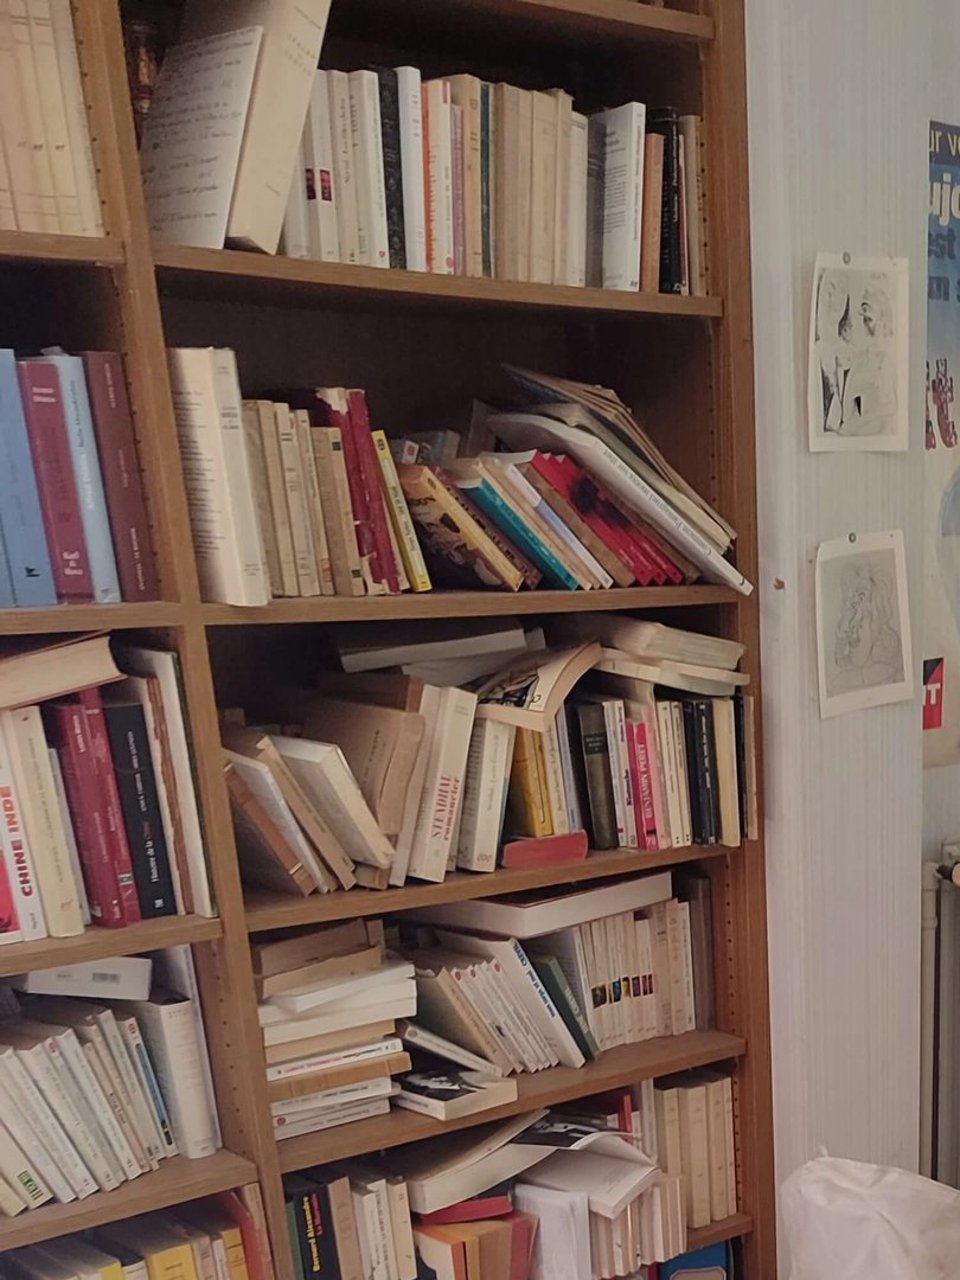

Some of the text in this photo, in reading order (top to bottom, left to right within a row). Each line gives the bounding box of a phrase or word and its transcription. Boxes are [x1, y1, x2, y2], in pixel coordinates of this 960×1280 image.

[431, 776, 451, 838] STENDHAL
[641, 774, 653, 819] BENJAMIN
[1, 785, 33, 897] CHINE INDE
